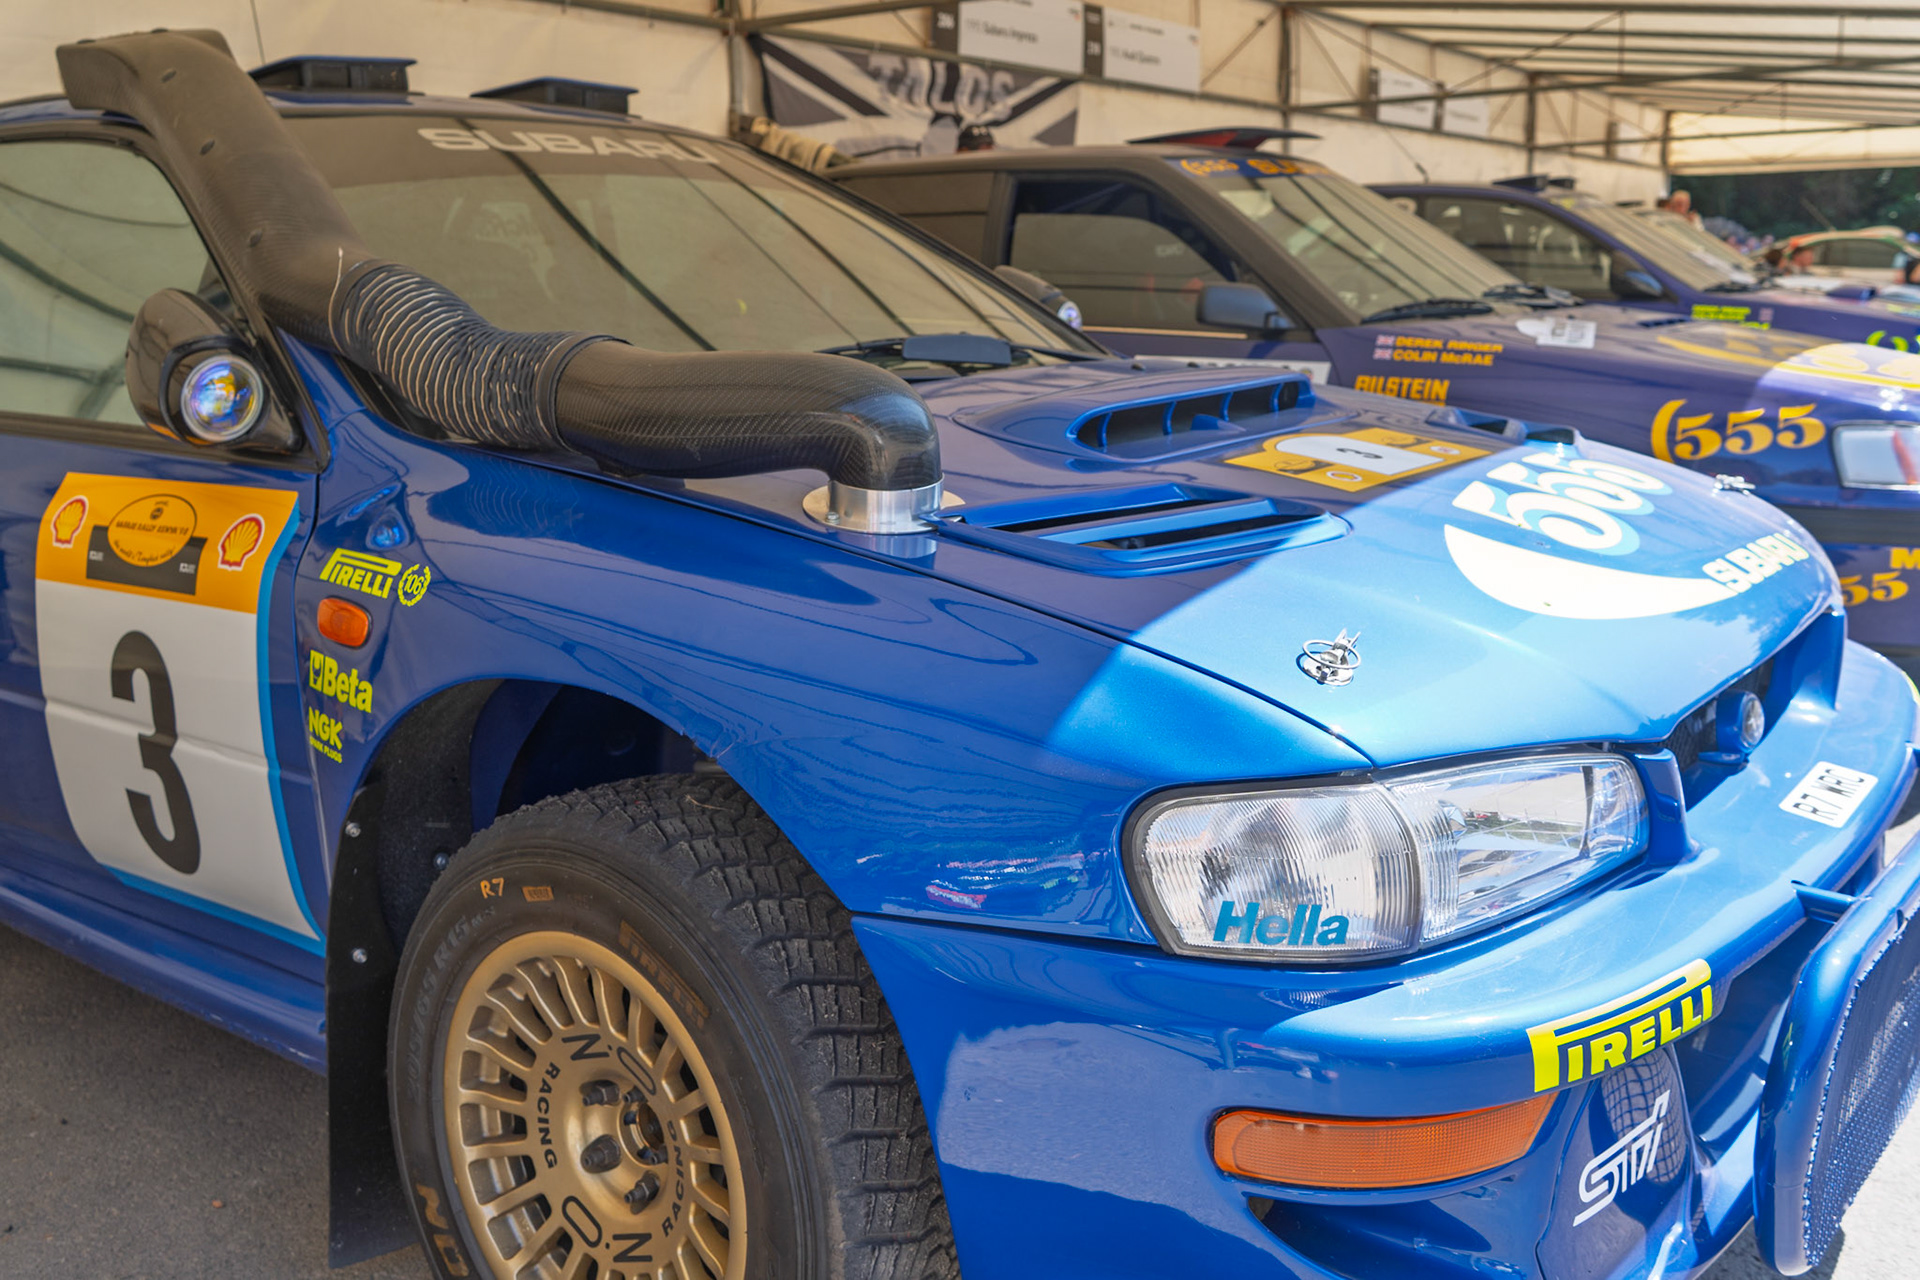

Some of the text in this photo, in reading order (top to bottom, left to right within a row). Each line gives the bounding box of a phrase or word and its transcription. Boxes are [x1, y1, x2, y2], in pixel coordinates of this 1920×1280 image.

[417, 128, 720, 164] SUBARU
[1393, 349, 1493, 366] COLIN McRAE
[1396, 336, 1503, 353] DEREK RINGER
[1336, 447, 1384, 460] 3
[1452, 452, 1672, 555] 555
[319, 547, 425, 599] PIRELLI 106
[1702, 532, 1810, 593] SUBARU
[323, 655, 373, 713] Beta
[110, 630, 201, 875] 3
[308, 705, 343, 751] NGK
[480, 877, 505, 899] R7
[1213, 900, 1350, 946] Hella
[1526, 958, 1713, 1093] PIRELLI
[537, 1062, 561, 1169] RACING
[661, 1120, 686, 1238] RACING
